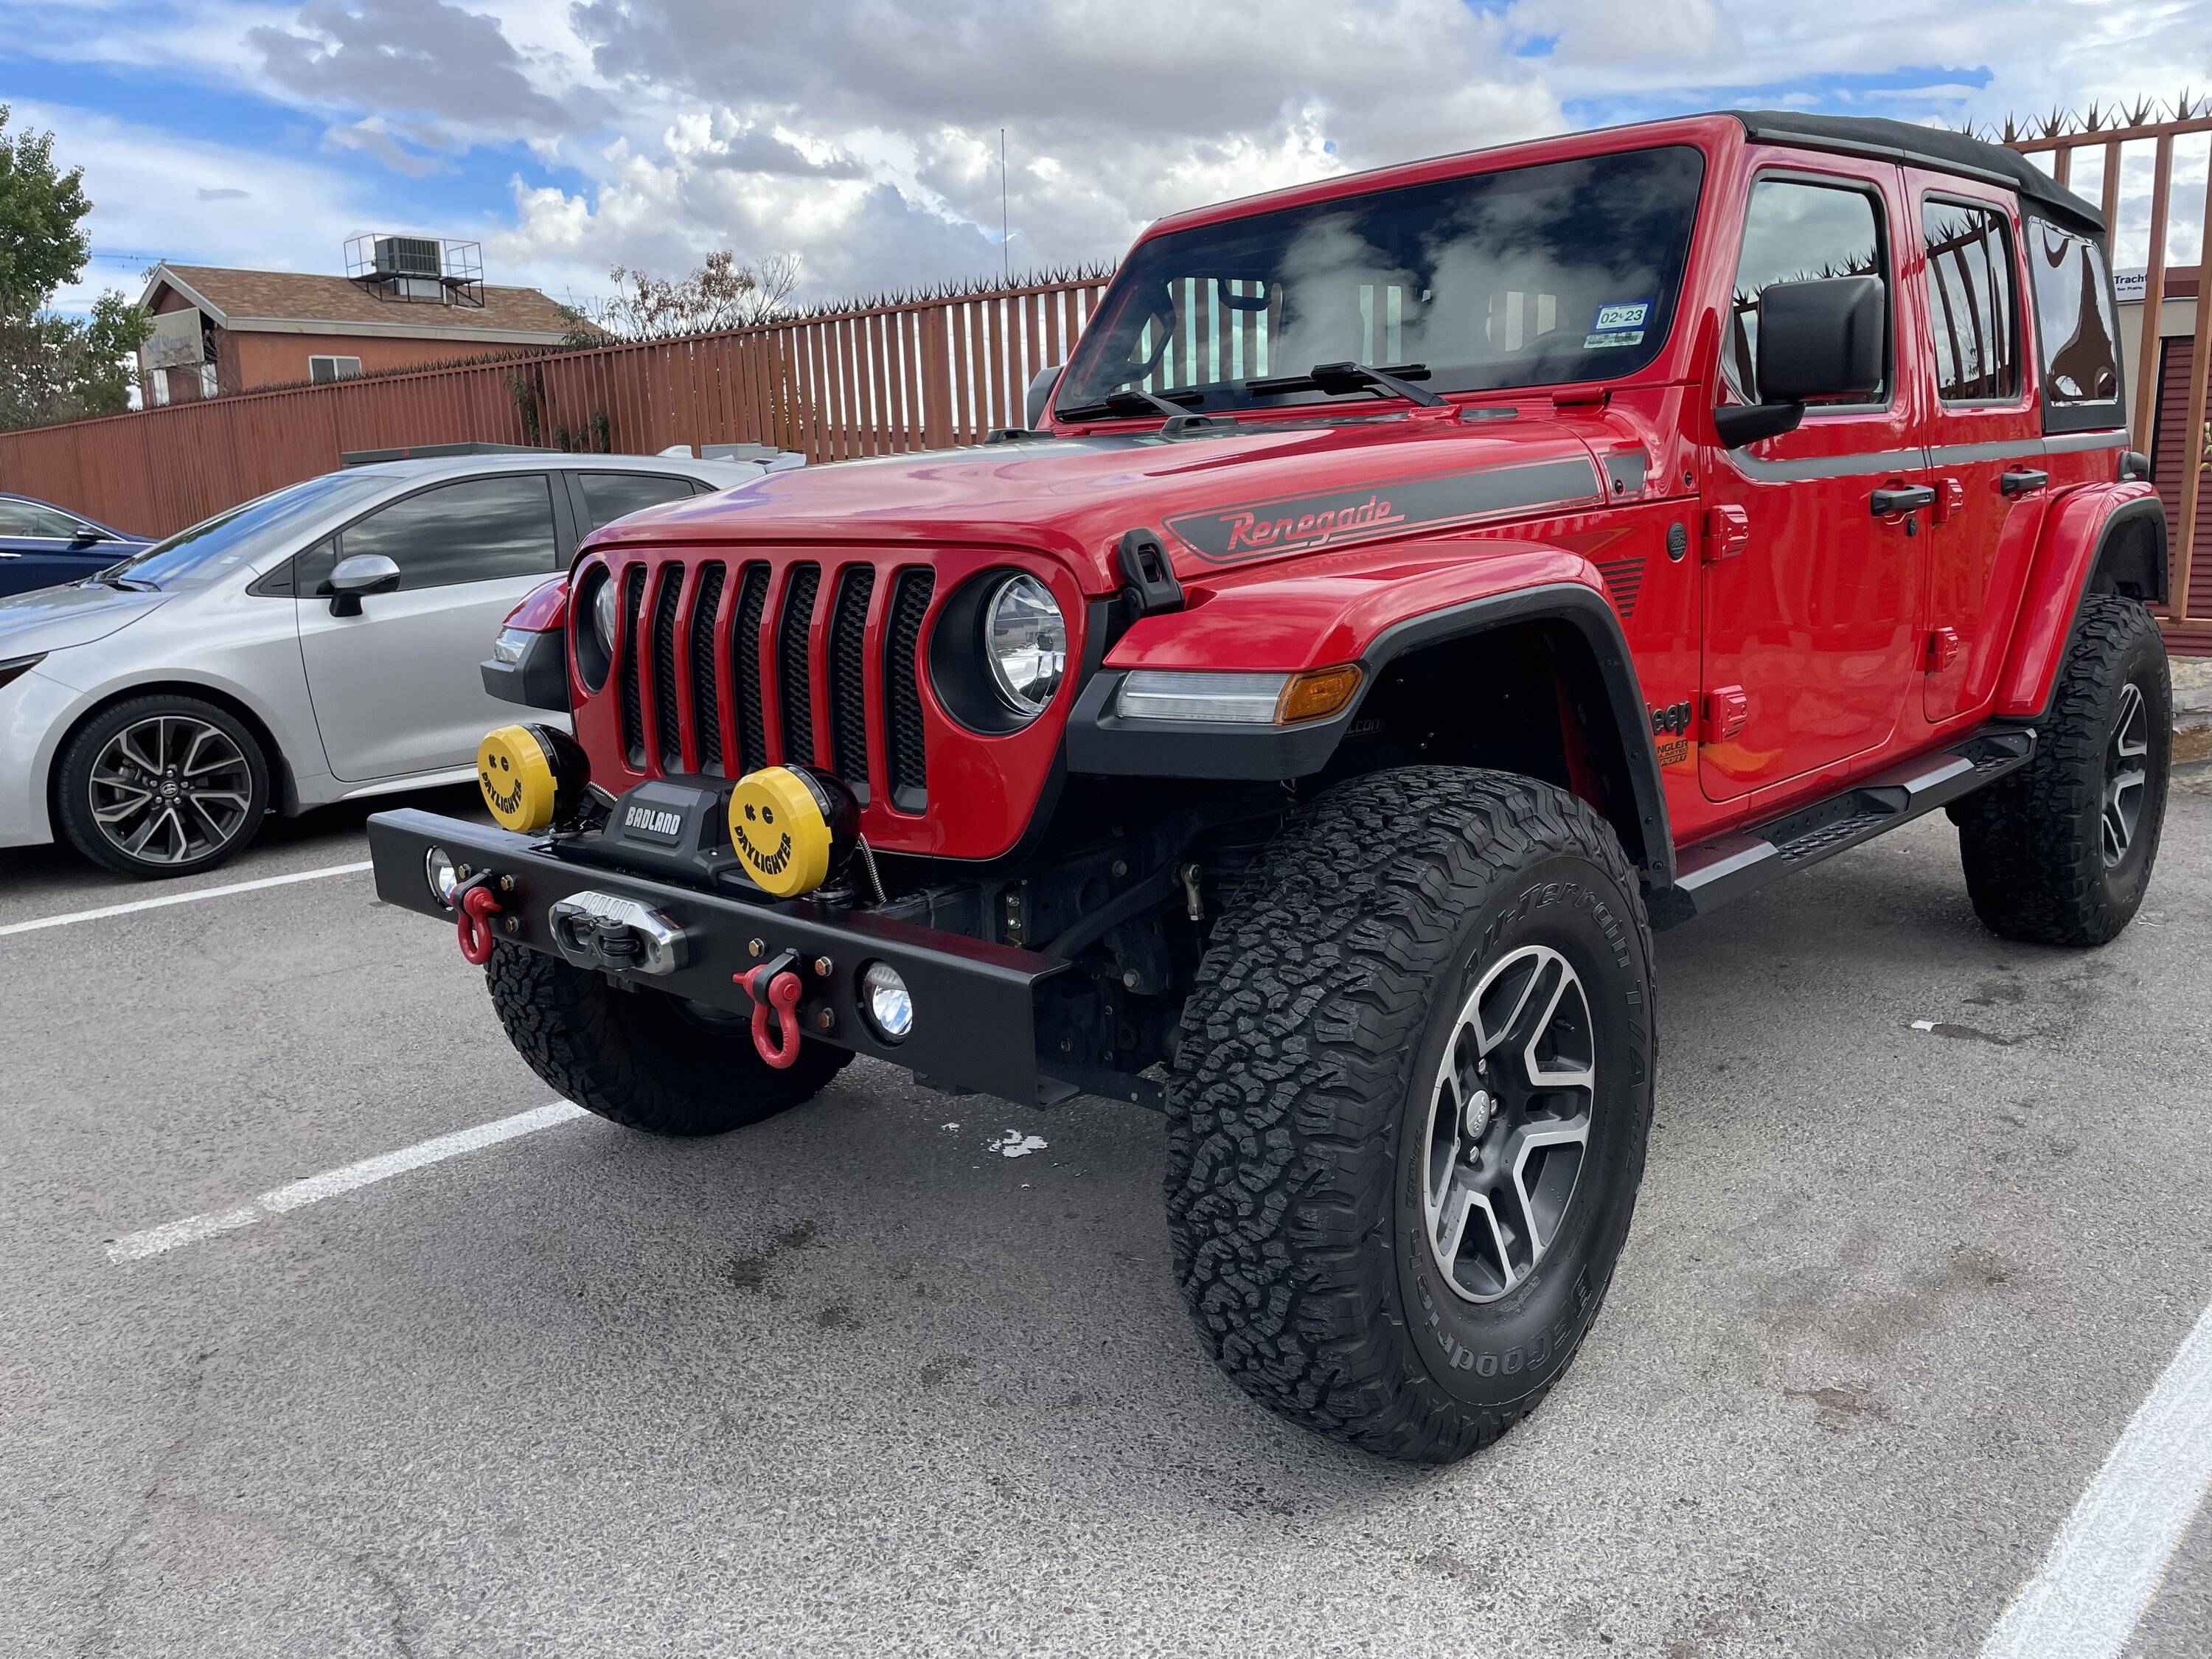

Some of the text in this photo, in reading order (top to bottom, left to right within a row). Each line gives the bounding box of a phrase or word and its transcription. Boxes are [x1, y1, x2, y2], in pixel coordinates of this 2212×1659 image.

[1219, 495, 1405, 552] Renegade
[1646, 700, 1692, 736] eep
[1658, 740, 1688, 753] NGLER
[481, 771, 522, 814] DAYLIGHTER
[625, 806, 681, 835] BADLAND
[734, 825, 791, 875] DAYLIGHTER
[580, 892, 636, 922] BADLAND
[1457, 883, 1631, 1007] All-Terrain
[1408, 1227, 1593, 1378] BFGoodrich
